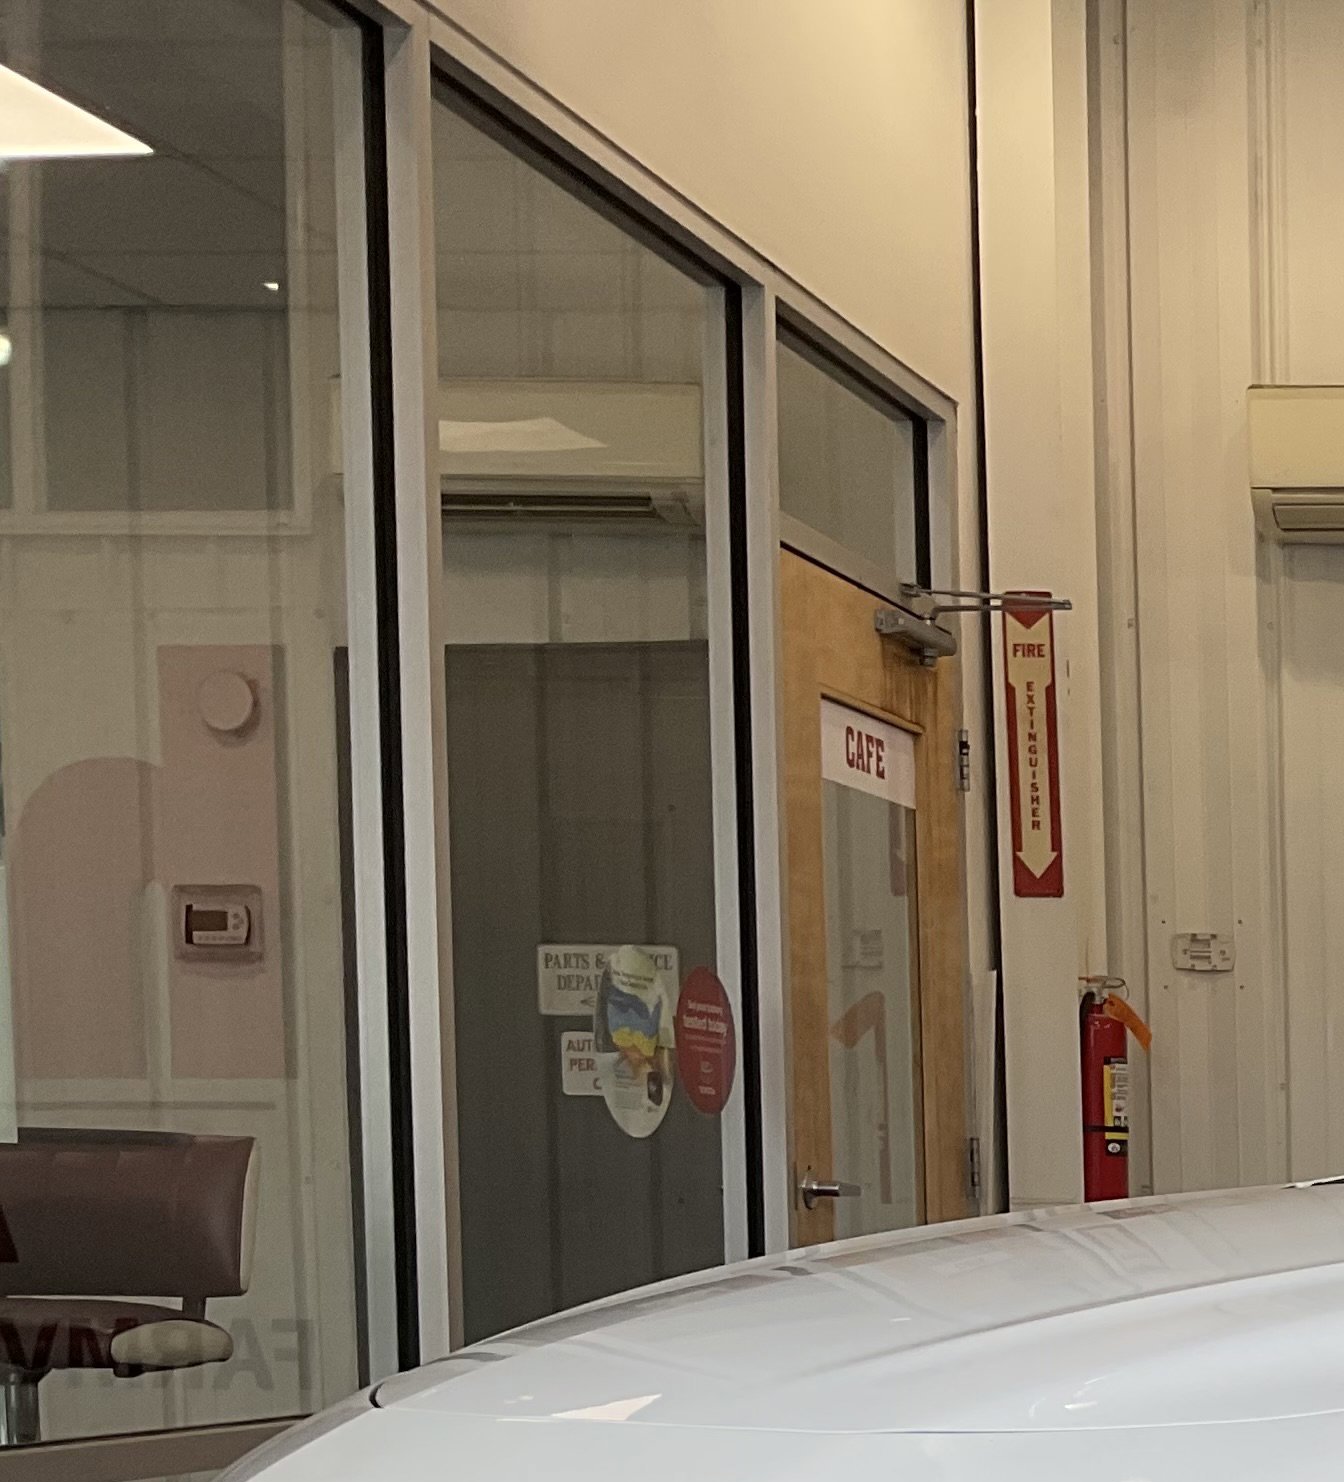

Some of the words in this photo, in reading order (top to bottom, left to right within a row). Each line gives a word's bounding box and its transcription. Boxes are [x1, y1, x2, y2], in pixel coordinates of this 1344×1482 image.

[1012, 643, 1046, 659] FIRE
[845, 725, 886, 780] CAFE
[1025, 681, 1041, 831] EXTINGUISHER
[544, 952, 591, 970] PARTS
